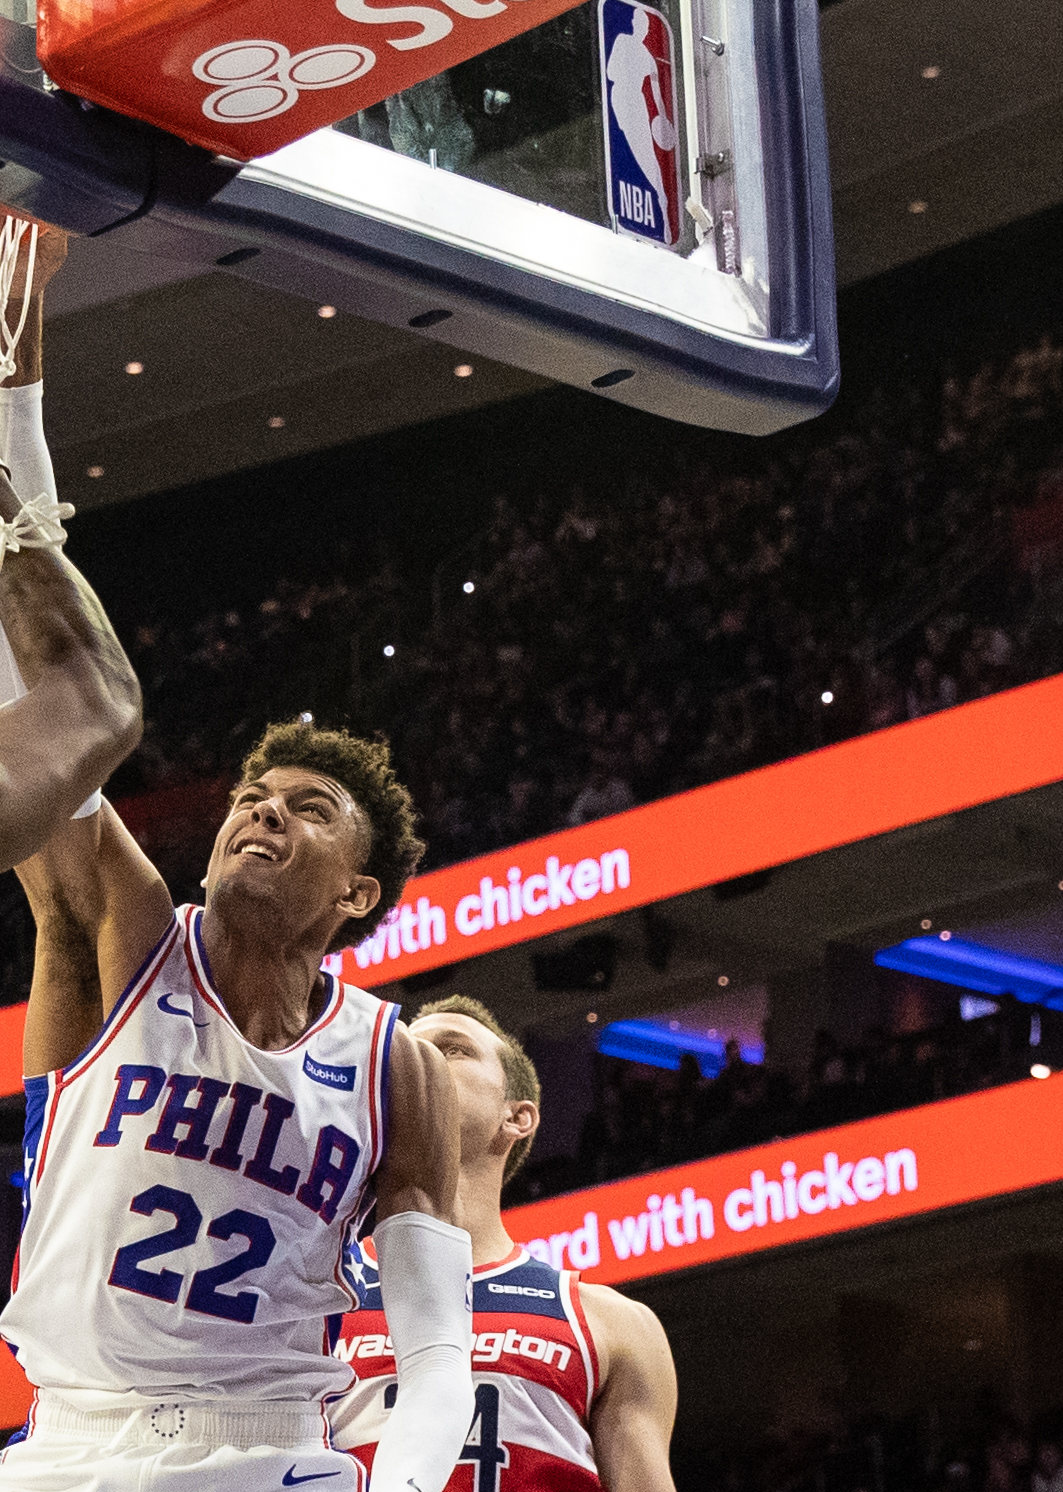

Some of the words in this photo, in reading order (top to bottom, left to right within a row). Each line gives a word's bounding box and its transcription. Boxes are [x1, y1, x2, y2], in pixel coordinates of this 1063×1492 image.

[619, 180, 656, 229] NBA
[455, 848, 631, 936] chicken
[93, 1064, 360, 1225] PHILA
[108, 1183, 277, 1324] 22
[607, 1187, 715, 1260] with
[723, 1148, 918, 1232] chicken
[488, 1283, 556, 1300] GEICO
